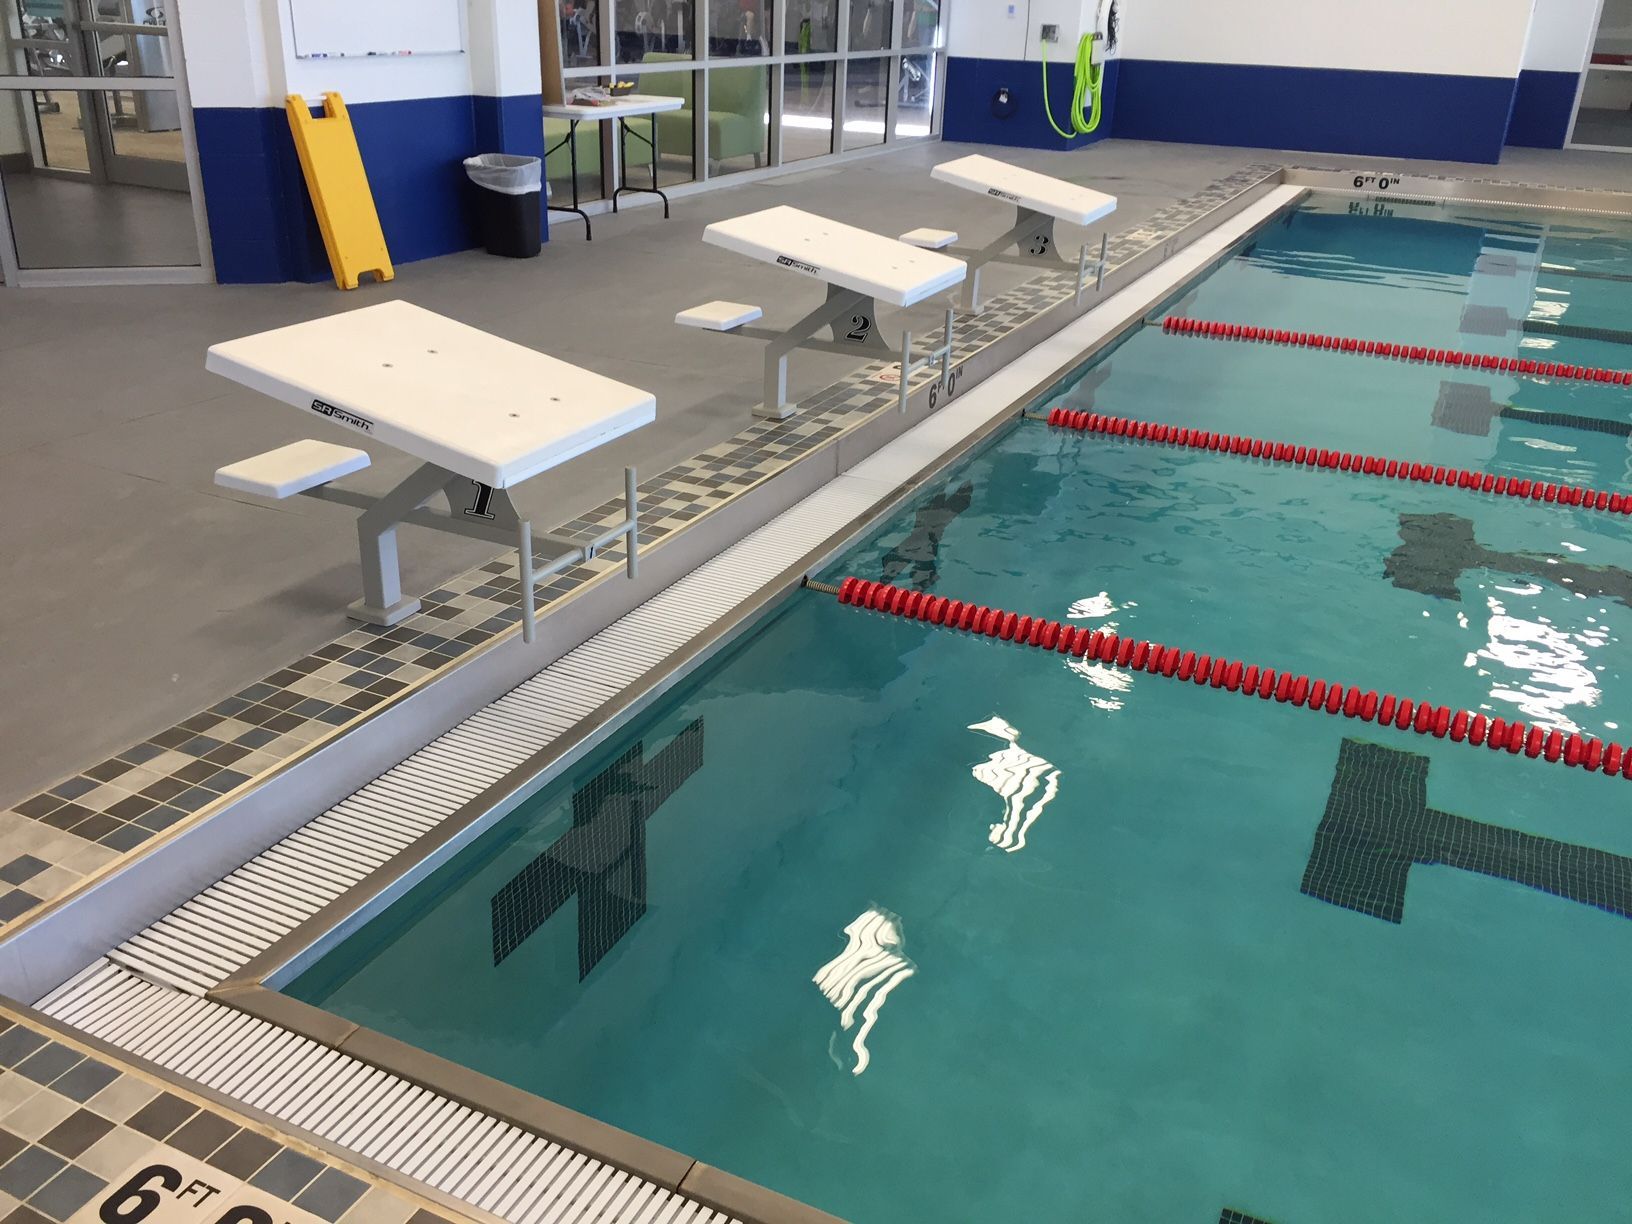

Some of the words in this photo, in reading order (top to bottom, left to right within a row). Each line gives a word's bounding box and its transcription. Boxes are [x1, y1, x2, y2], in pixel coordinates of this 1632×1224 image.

[1029, 235, 1049, 256] 3
[844, 314, 872, 343] 2
[464, 479, 496, 520] 1
